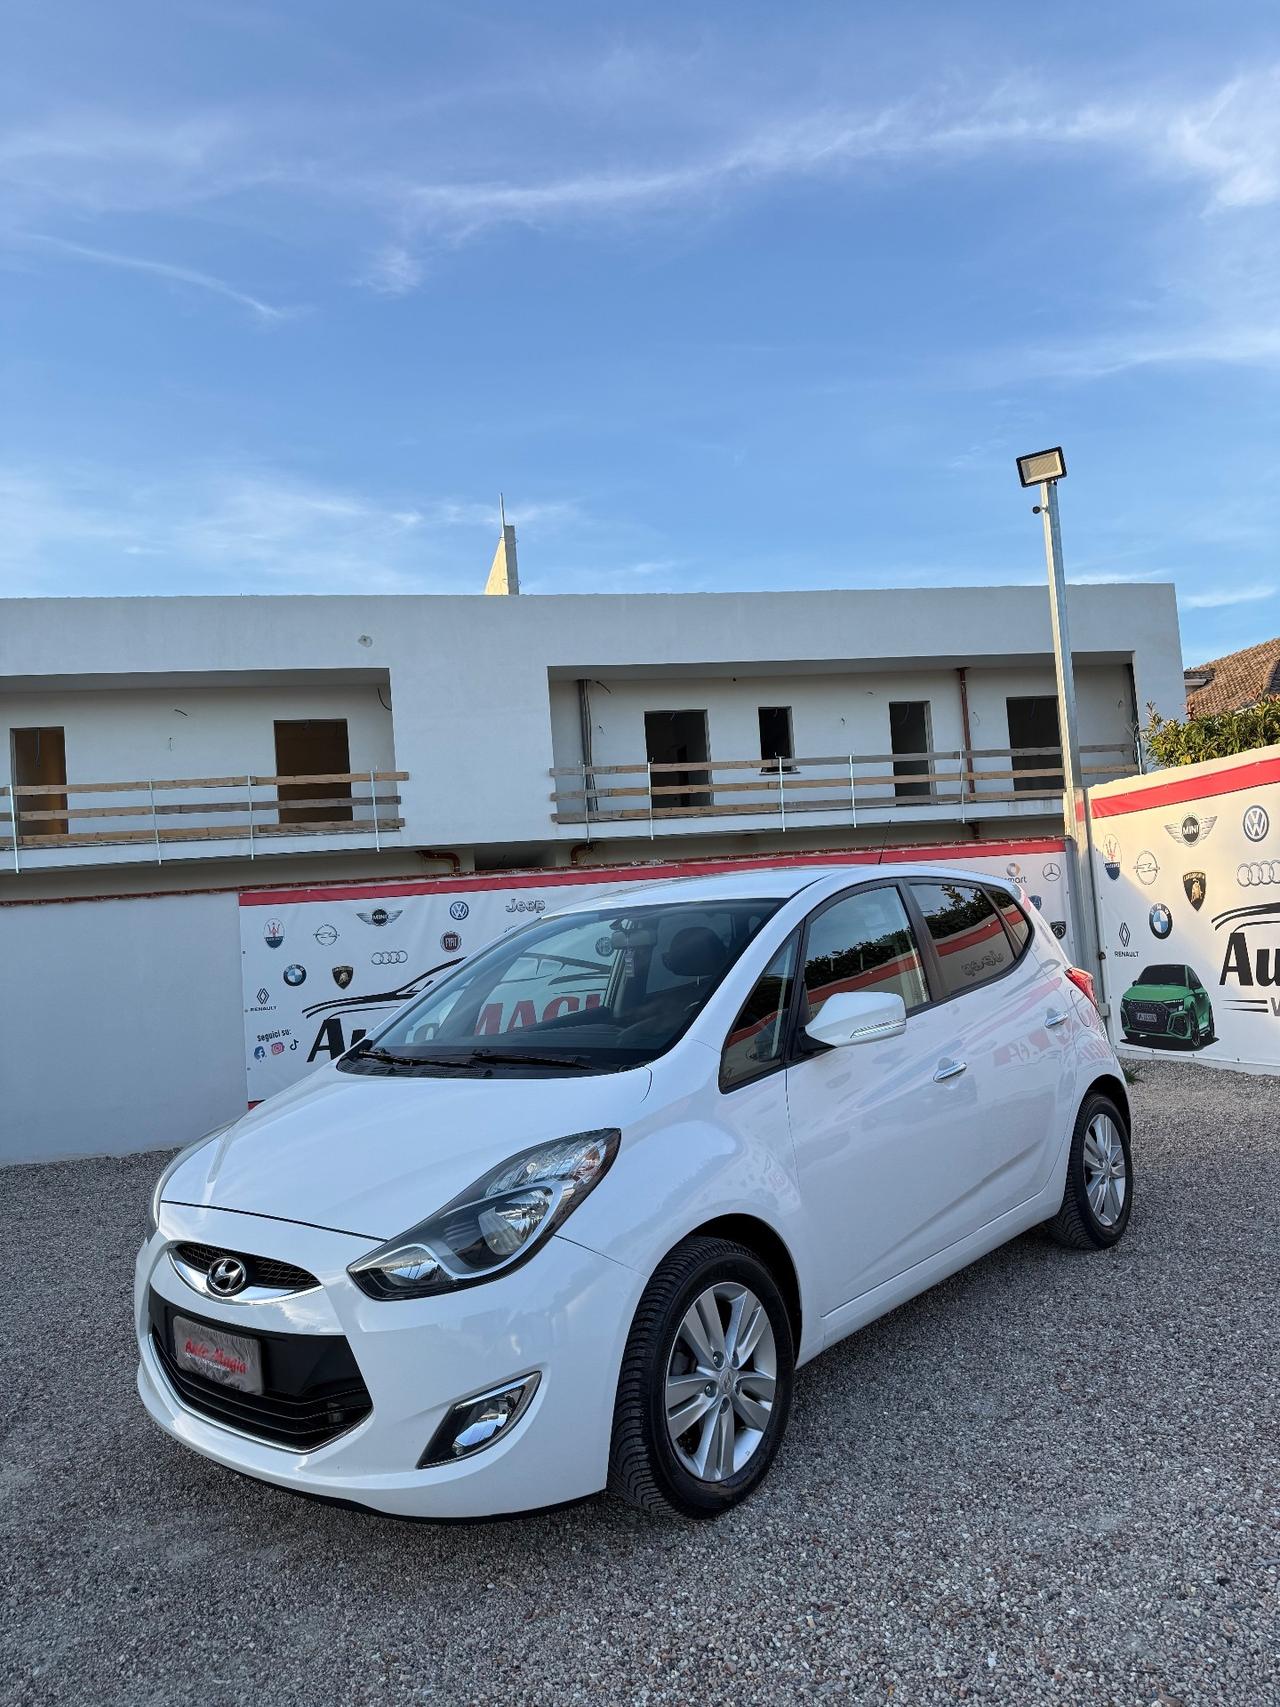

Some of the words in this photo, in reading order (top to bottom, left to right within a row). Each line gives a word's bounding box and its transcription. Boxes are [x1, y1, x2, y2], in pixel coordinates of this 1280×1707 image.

[1182, 825, 1199, 834] MINI
[1003, 876, 1027, 884] mart
[505, 898, 545, 914] Jeep
